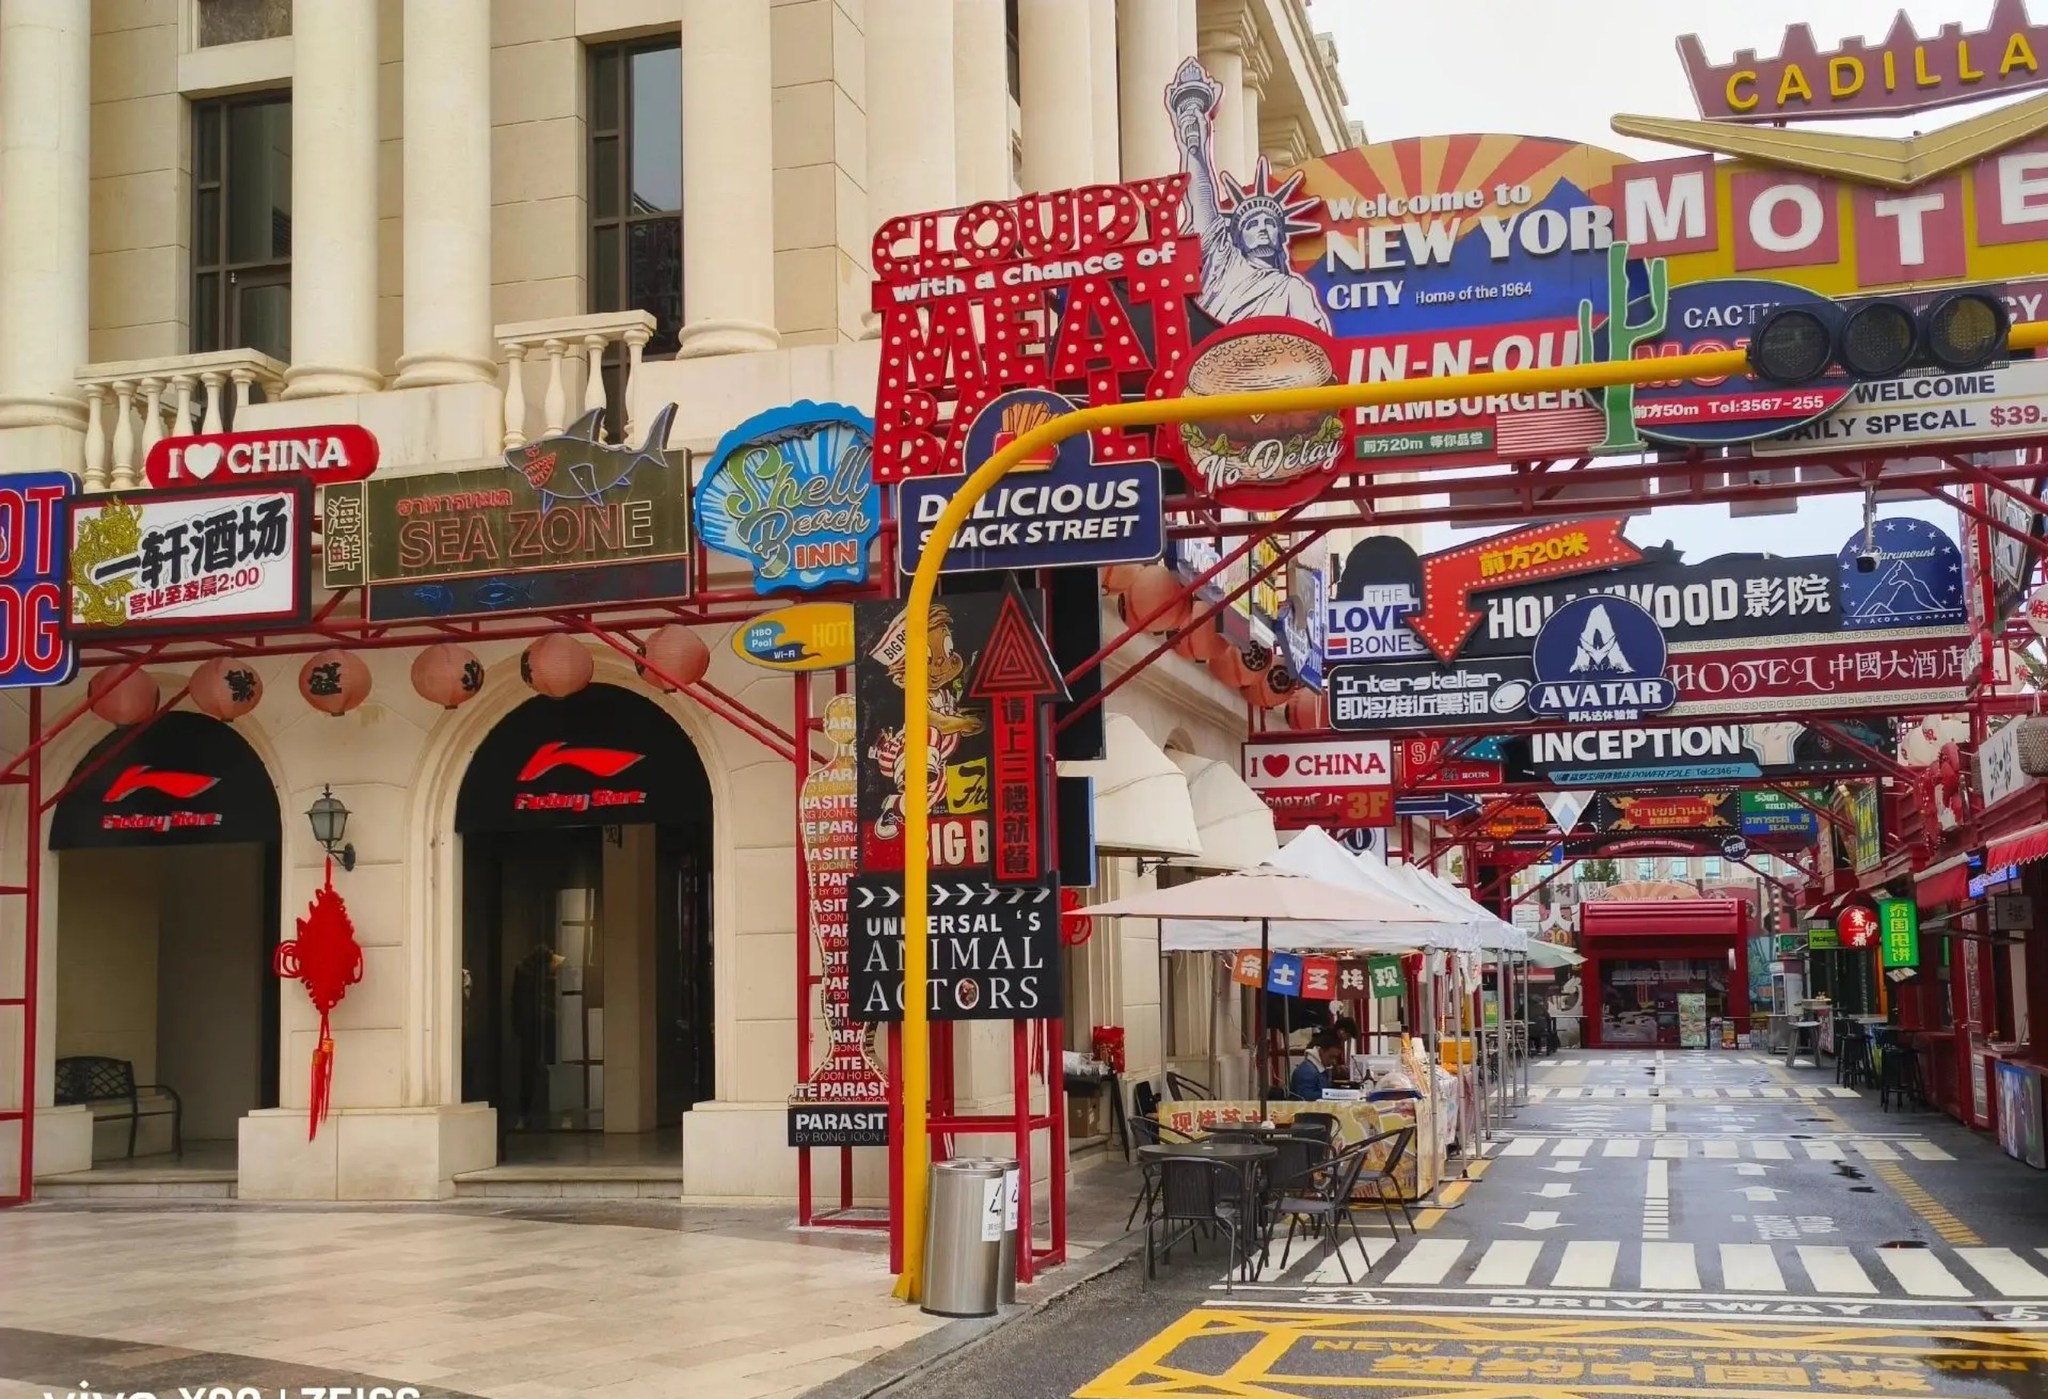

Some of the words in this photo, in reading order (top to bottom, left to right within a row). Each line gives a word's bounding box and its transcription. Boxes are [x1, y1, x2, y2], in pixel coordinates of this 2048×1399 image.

[1725, 32, 2038, 110] CADILLA
[1327, 187, 1485, 222] Welcome
[1494, 182, 1533, 207] to
[1624, 152, 2048, 265] MOTE
[873, 173, 1191, 279] CLOUDY
[1325, 220, 1459, 273] NEW
[1479, 205, 1614, 259] YOR
[892, 276, 965, 302] with
[974, 271, 996, 291] a
[1002, 252, 1125, 286] chance
[1137, 242, 1177, 267] of
[1327, 280, 1405, 312] CITY
[1415, 289, 1455, 306] Home
[1458, 287, 1473, 302] of
[1475, 285, 1498, 301] the
[1500, 280, 1533, 299] 1964
[880, 271, 1202, 390] MEAT
[1355, 388, 1586, 425] HAMBURGER
[1708, 396, 1825, 414] Tel:3567-255
[1855, 375, 1996, 404] WELCOME
[1776, 417, 1861, 443] AILY
[1866, 409, 1977, 435] SPECAL
[168, 448, 182, 479] I
[226, 437, 349, 475] CHINA
[1197, 455, 1242, 494] No
[1249, 437, 1344, 480] Delay
[723, 443, 873, 519] Shell
[917, 478, 1140, 524] DLICIOUS
[94, 497, 288, 590] 一轩酒场
[399, 515, 500, 568] SEA
[508, 500, 653, 557] ZONE
[736, 501, 871, 580] Beach
[1024, 515, 1140, 544] STREET
[794, 538, 858, 570] INN
[1480, 531, 1590, 577] 前方20米
[129, 568, 260, 616] 营业至凌晨2:00
[1369, 588, 1404, 604] THE
[1742, 573, 1832, 619] 影院
[751, 627, 772, 636] HBO
[1328, 603, 1420, 634] LOVE
[883, 641, 903, 660] BIG
[1336, 671, 1503, 696] Interstellar
[1666, 655, 1835, 694] HOTEL
[1539, 680, 1663, 710] AVATAR
[1531, 724, 1741, 763] INCEPTION
[1250, 757, 1258, 778] I
[1295, 752, 1387, 777] CHINA
[1346, 790, 1389, 820] 3F
[863, 936, 1044, 973] AIMAL
[1488, 1296, 1874, 1316] DRIVEWAY
[1312, 1339, 1438, 1354] NEW
[1464, 1343, 1623, 1359] YORK
[1648, 1350, 2029, 1372] CHINATOWN
